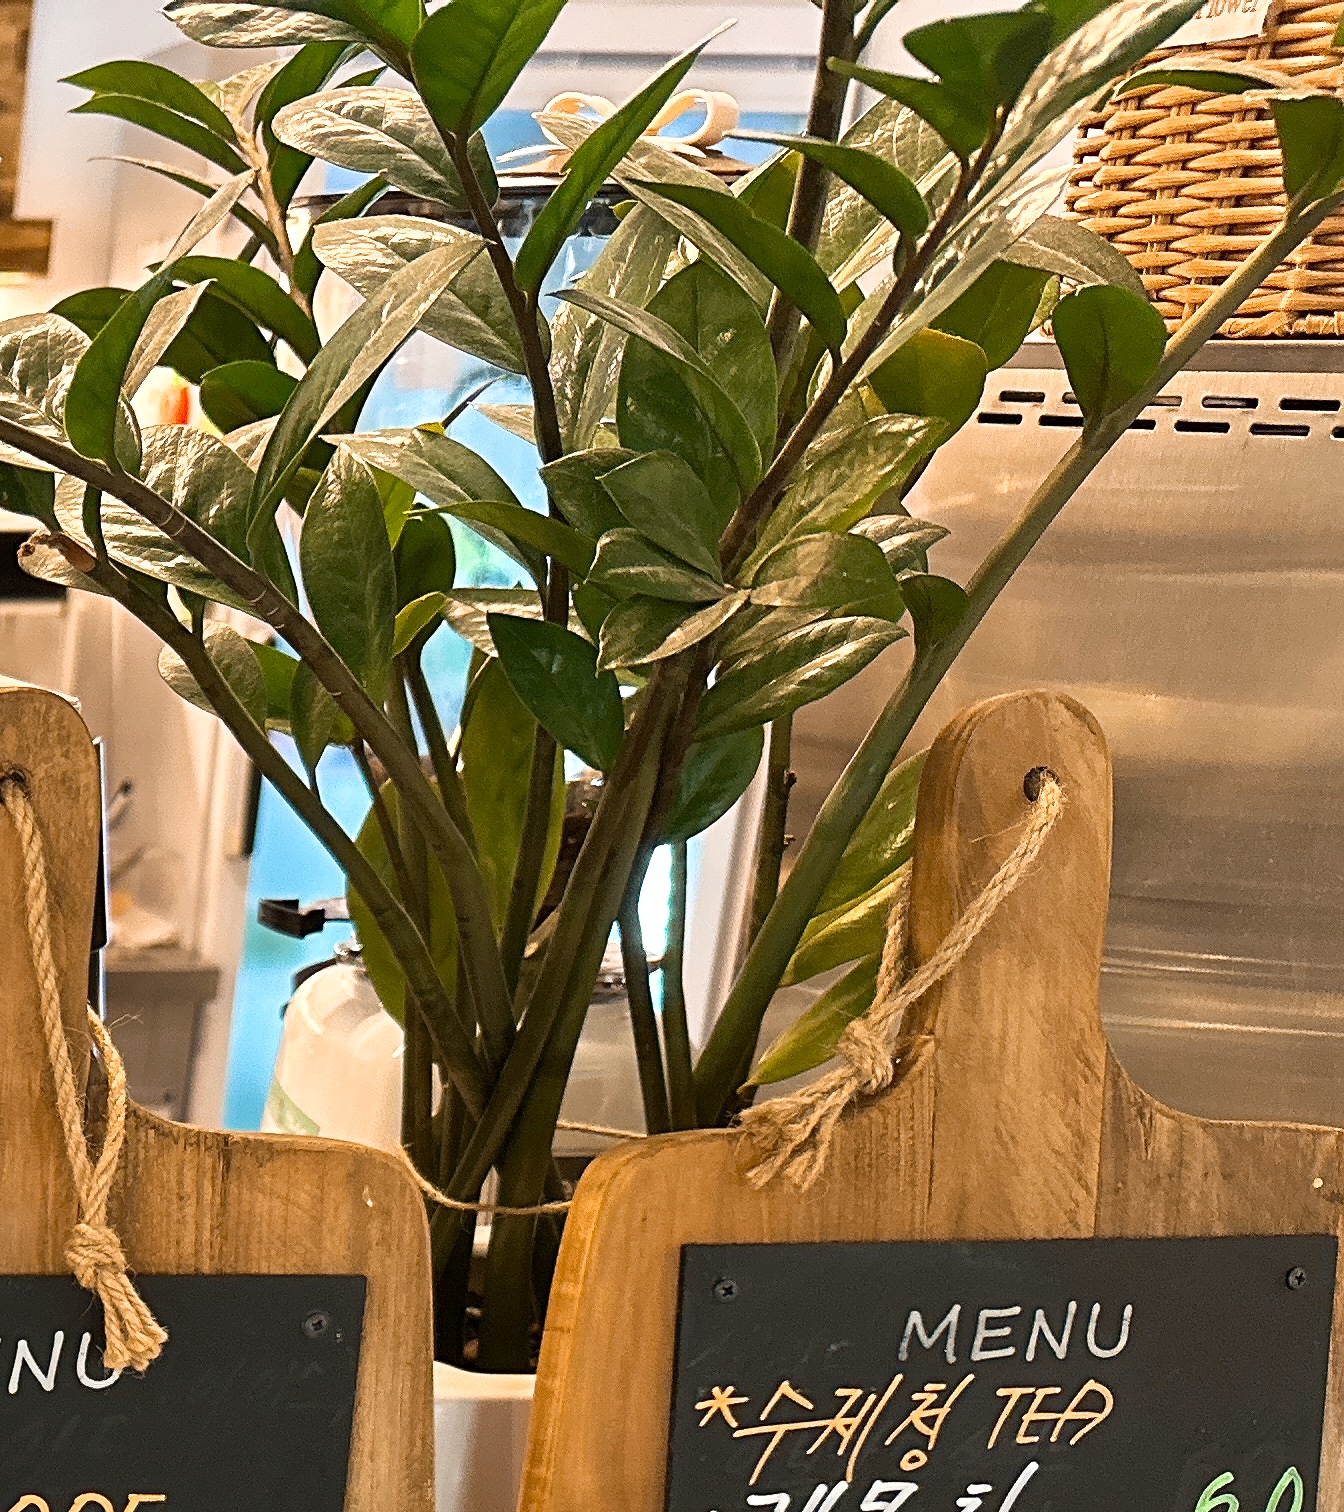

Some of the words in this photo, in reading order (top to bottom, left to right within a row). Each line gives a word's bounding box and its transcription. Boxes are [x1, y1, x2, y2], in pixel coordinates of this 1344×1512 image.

[899, 1301, 1132, 1363] MENU
[733, 1374, 975, 1485] 수제청
[988, 1379, 1113, 1449] TEA
